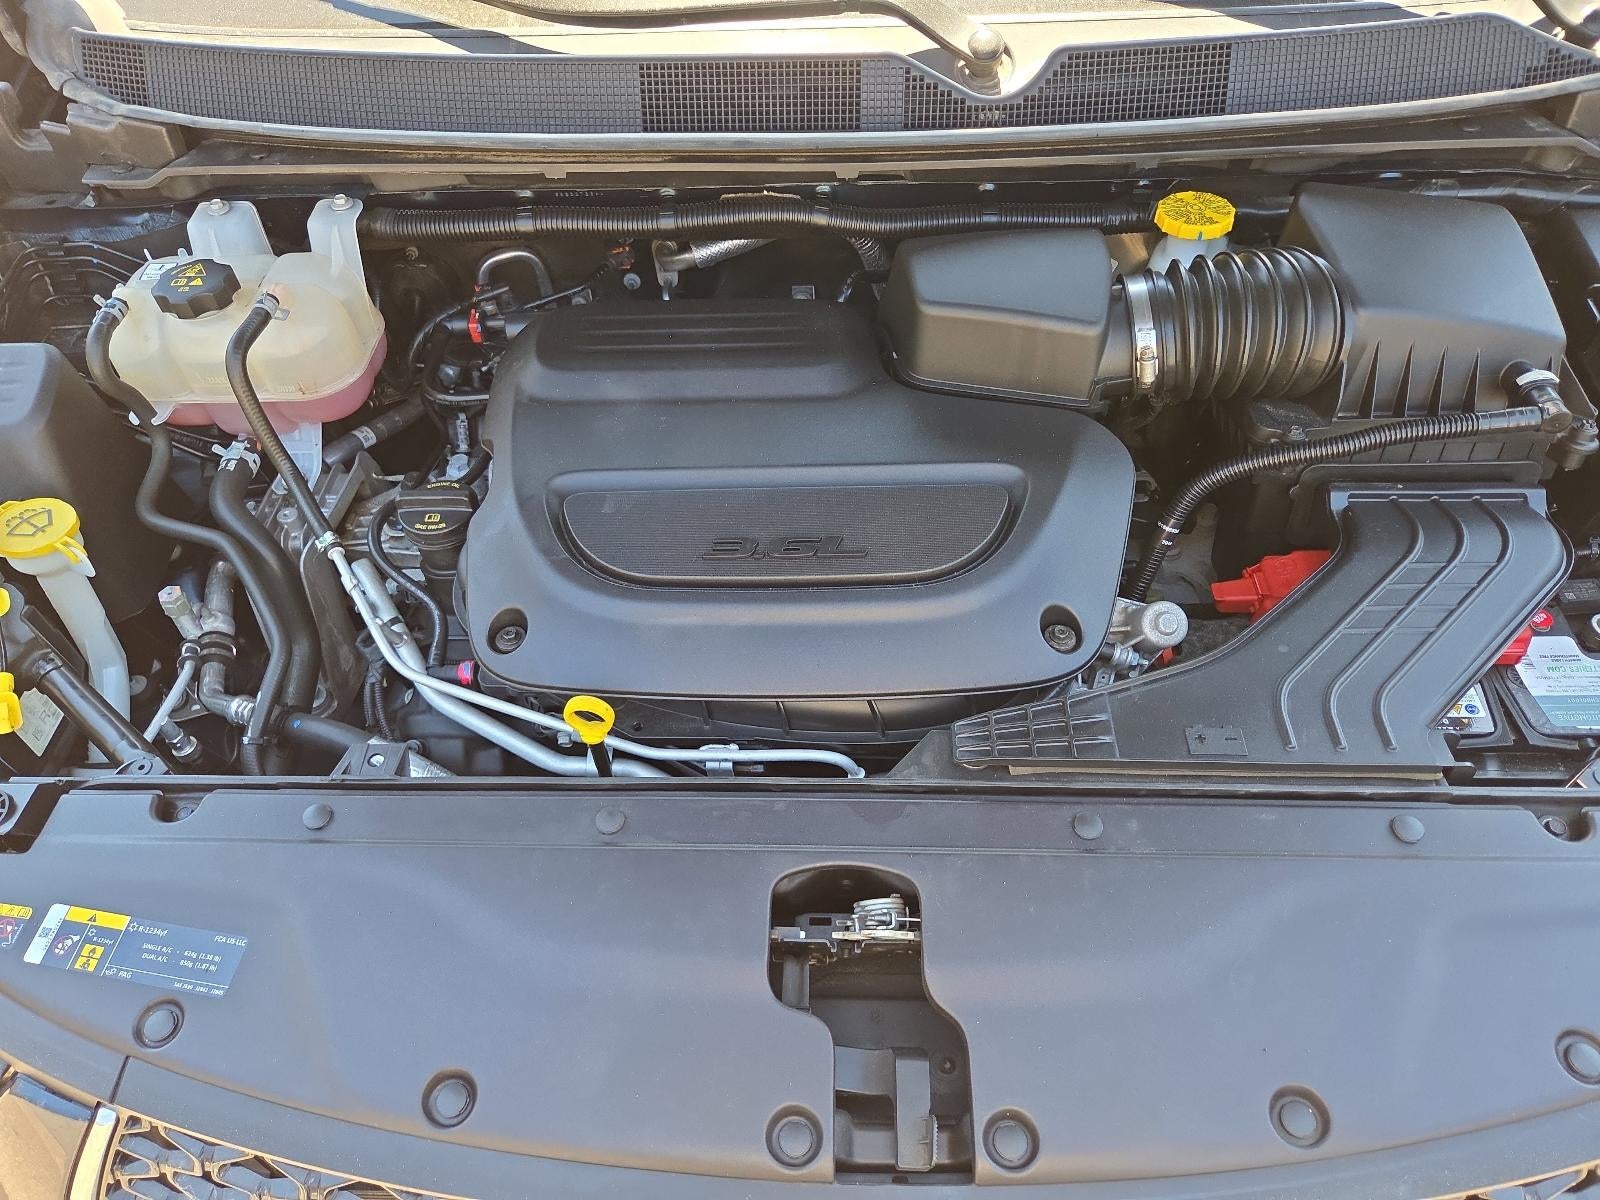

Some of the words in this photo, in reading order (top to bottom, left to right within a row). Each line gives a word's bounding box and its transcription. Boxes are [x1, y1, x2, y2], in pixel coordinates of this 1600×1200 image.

[702, 535, 869, 561] 3.6L
[138, 925, 168, 938] R-1234yf
[214, 935, 226, 943] FCA
[226, 937, 235, 945] US
[235, 939, 247, 947] LLC
[142, 942, 162, 952] SINGLE
[142, 952, 157, 961] DUAL
[156, 955, 168, 963] A/C
[118, 970, 133, 979] PAG
